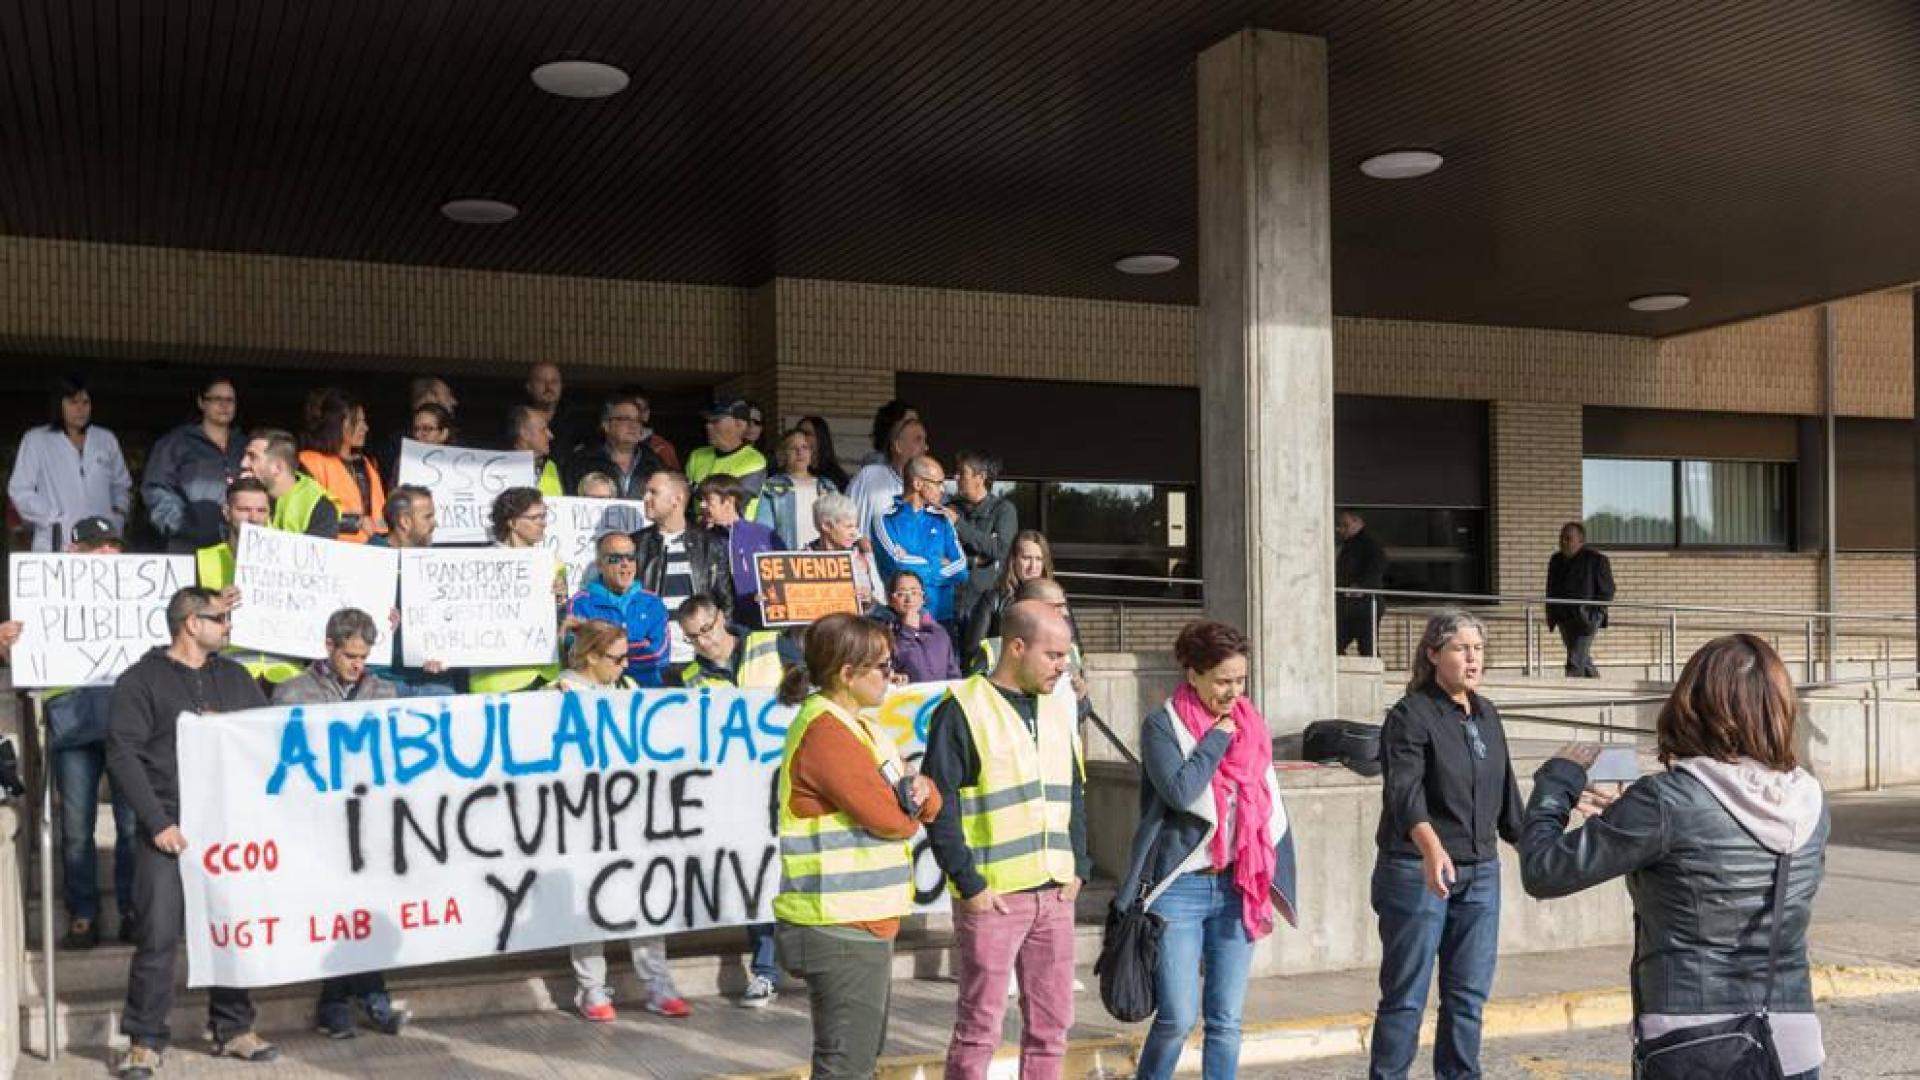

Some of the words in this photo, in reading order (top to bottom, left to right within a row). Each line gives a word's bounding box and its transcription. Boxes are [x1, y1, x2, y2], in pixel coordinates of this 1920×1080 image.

[421, 449, 508, 494] SSG
[293, 541, 326, 575] UN
[409, 554, 530, 584] TRANSPORTE
[761, 558, 785, 580] SE
[789, 557, 851, 579] VENDE
[15, 558, 182, 600] EMPRESA
[40, 603, 170, 643] PUBLIC
[522, 625, 549, 646] YA
[203, 839, 280, 875] CCOO
[210, 917, 280, 948] UGT
[309, 909, 372, 943] LAB
[401, 897, 463, 930] ELA
[485, 869, 537, 951] Y
